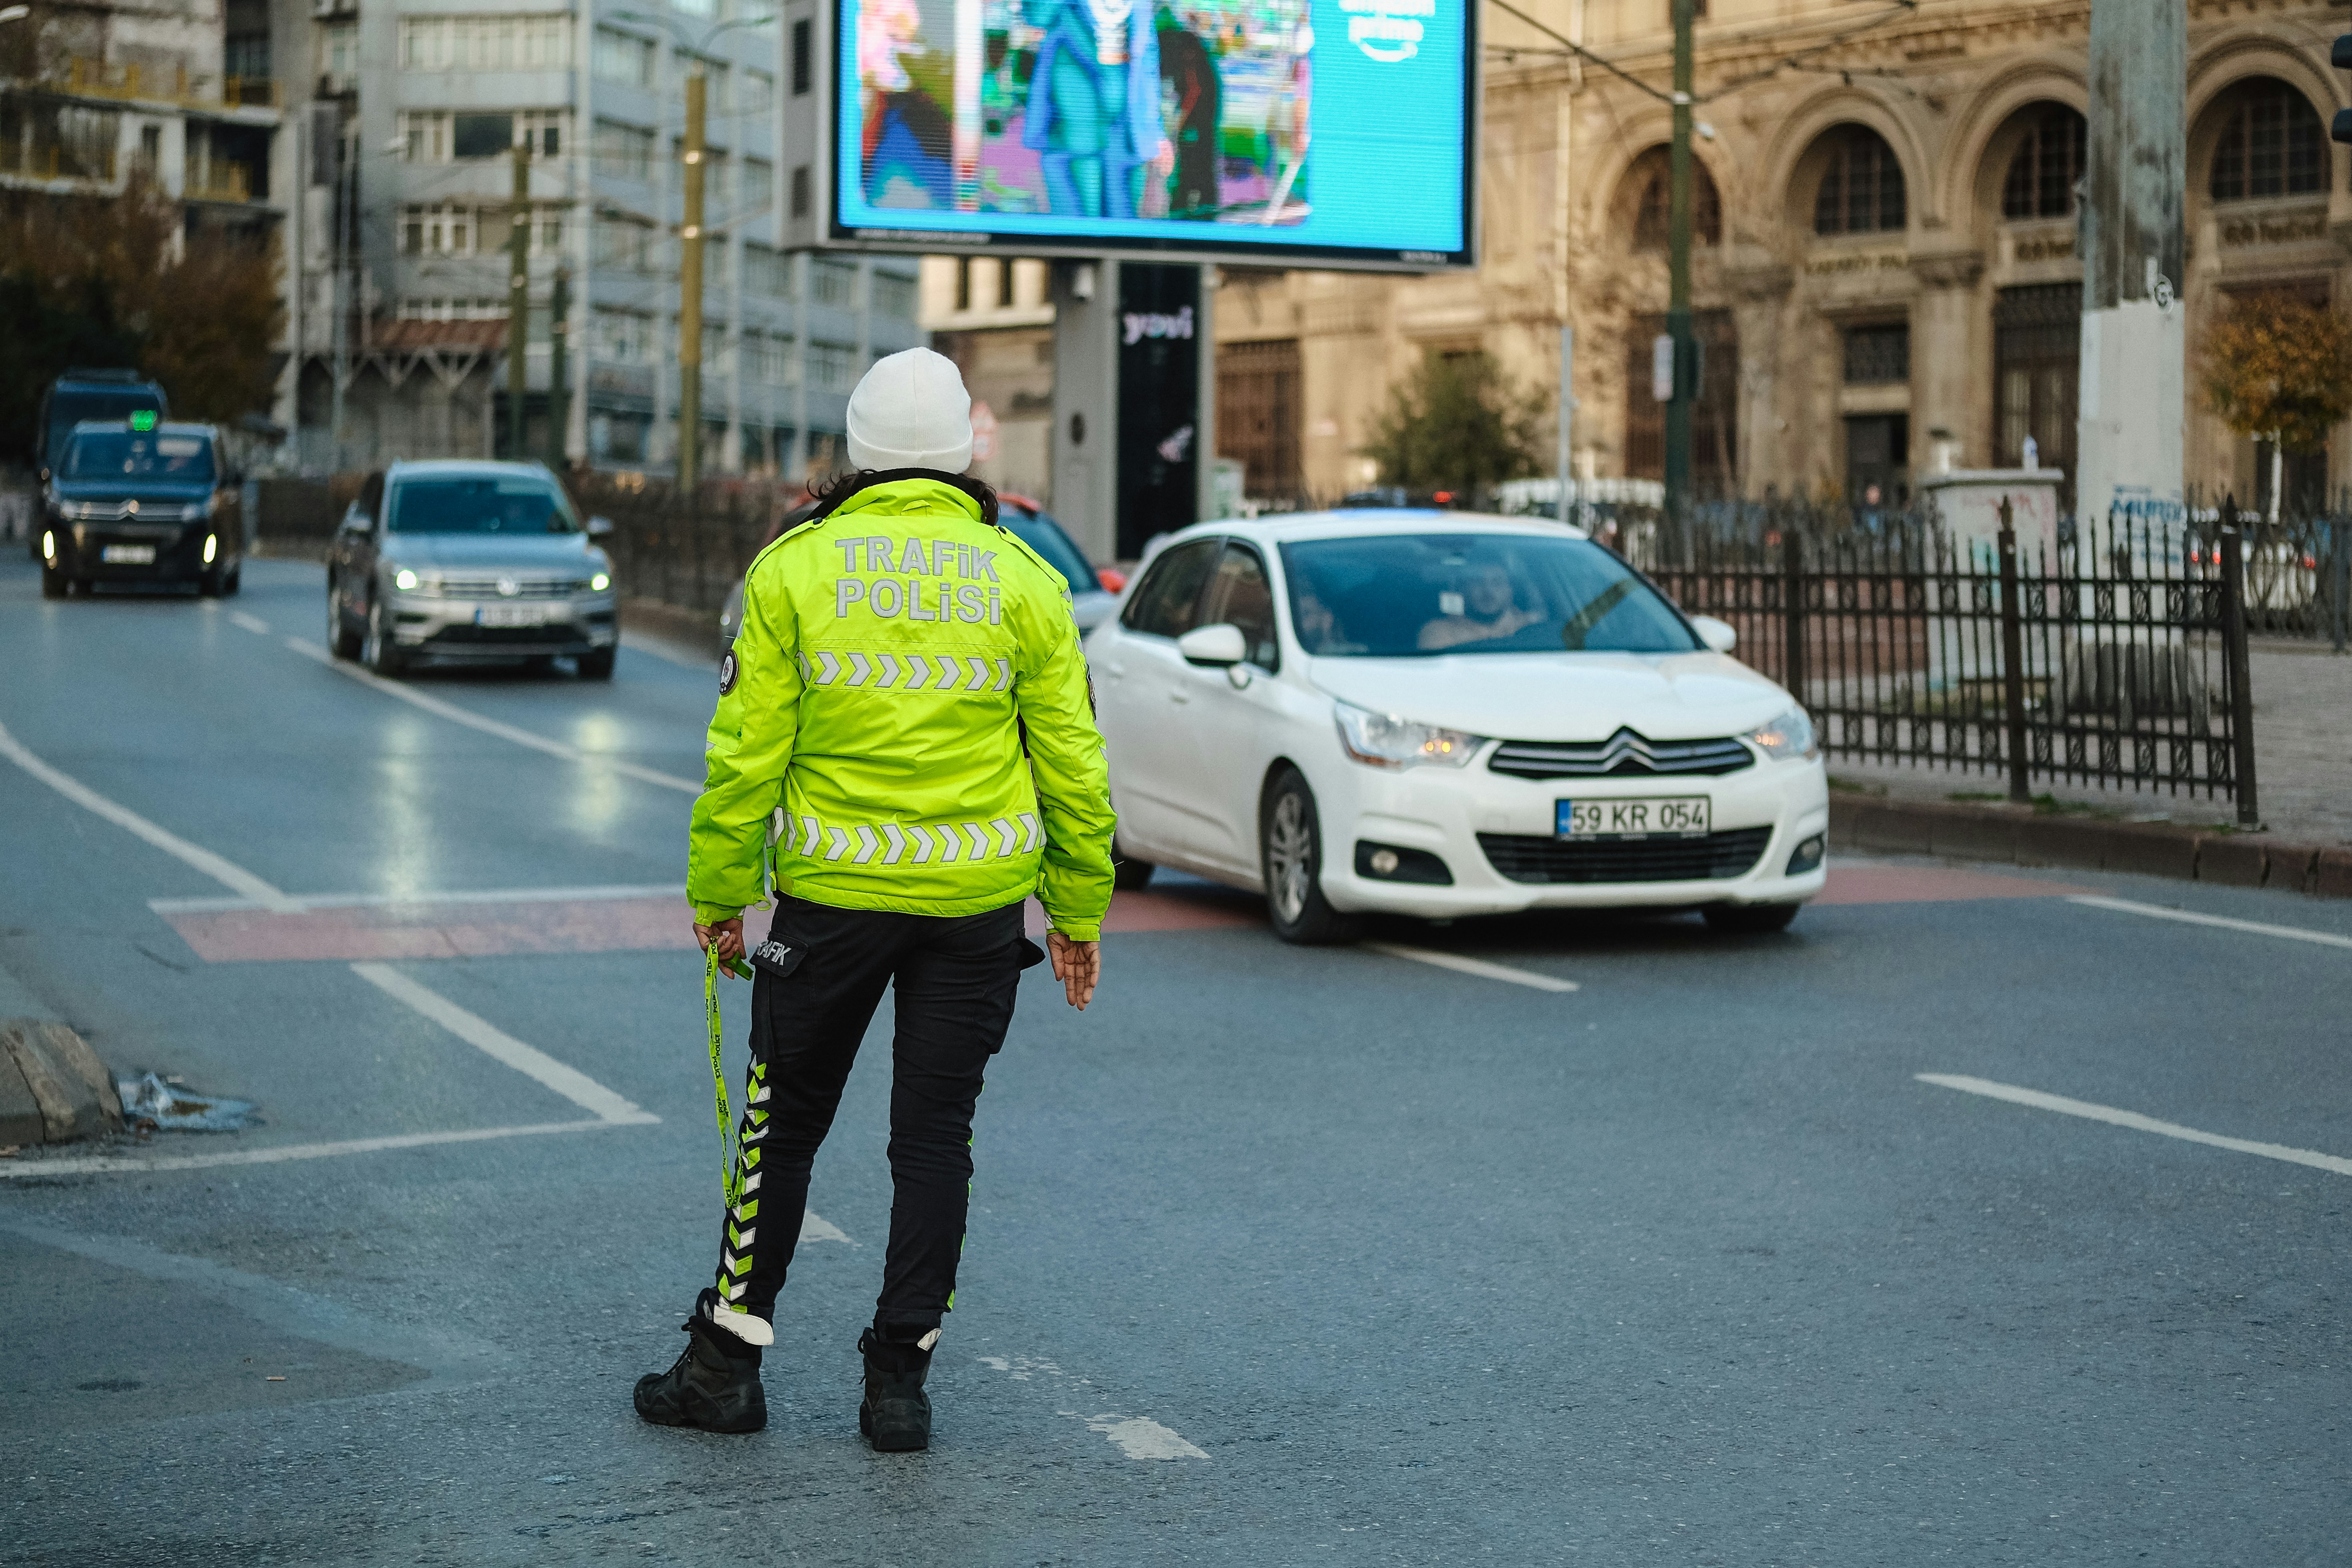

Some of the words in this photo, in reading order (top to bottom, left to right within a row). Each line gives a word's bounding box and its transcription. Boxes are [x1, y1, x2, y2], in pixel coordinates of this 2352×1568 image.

[1573, 805, 1601, 830] 59
[1612, 804, 1648, 830] KR
[1660, 803, 1704, 828] 054
